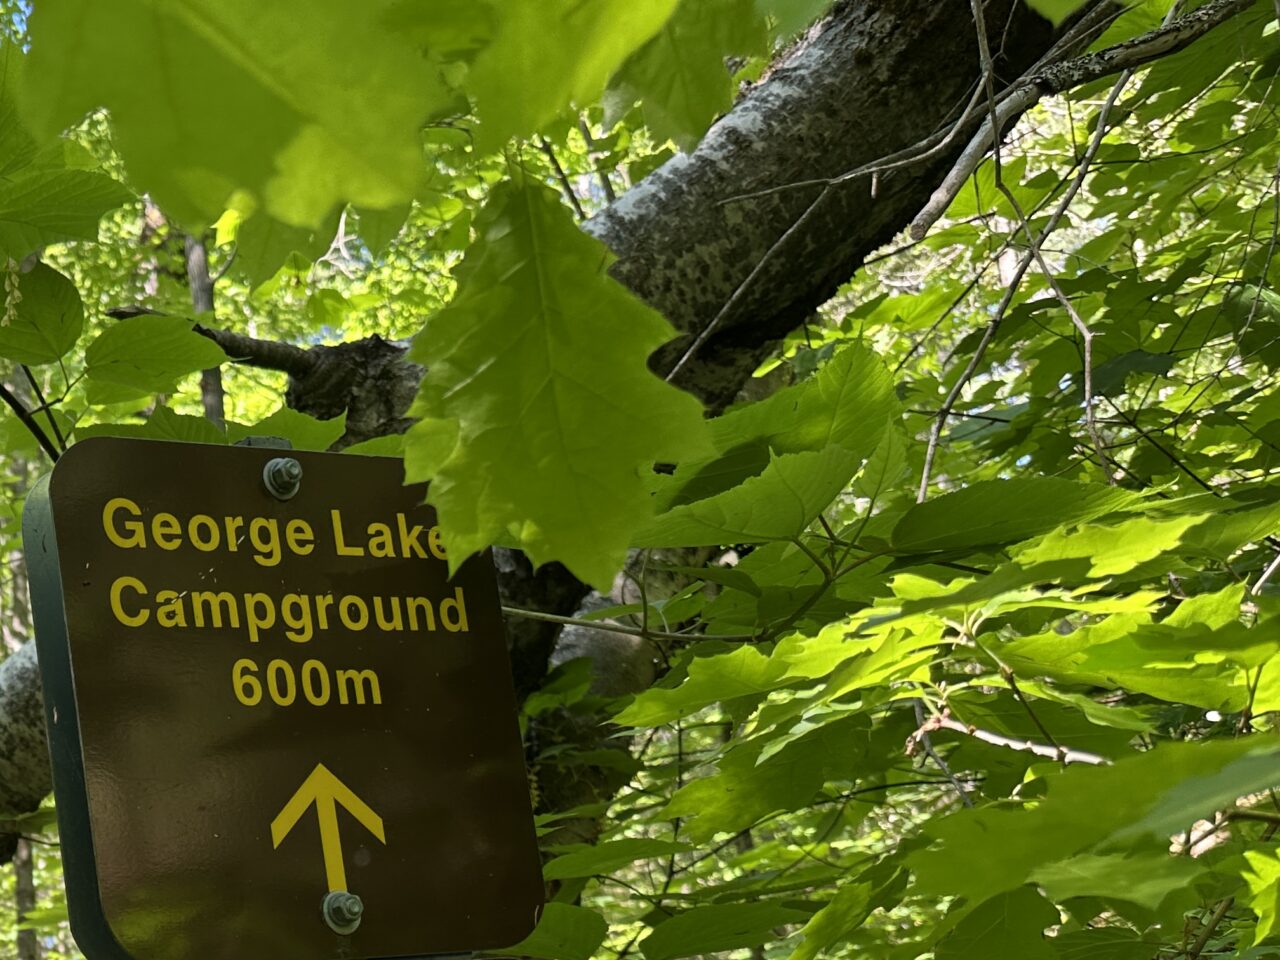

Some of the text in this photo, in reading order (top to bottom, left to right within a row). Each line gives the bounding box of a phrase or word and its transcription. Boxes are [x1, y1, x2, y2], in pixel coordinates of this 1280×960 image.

[103, 498, 315, 567] George
[110, 576, 470, 643] Campground
[232, 658, 382, 706] 600m
